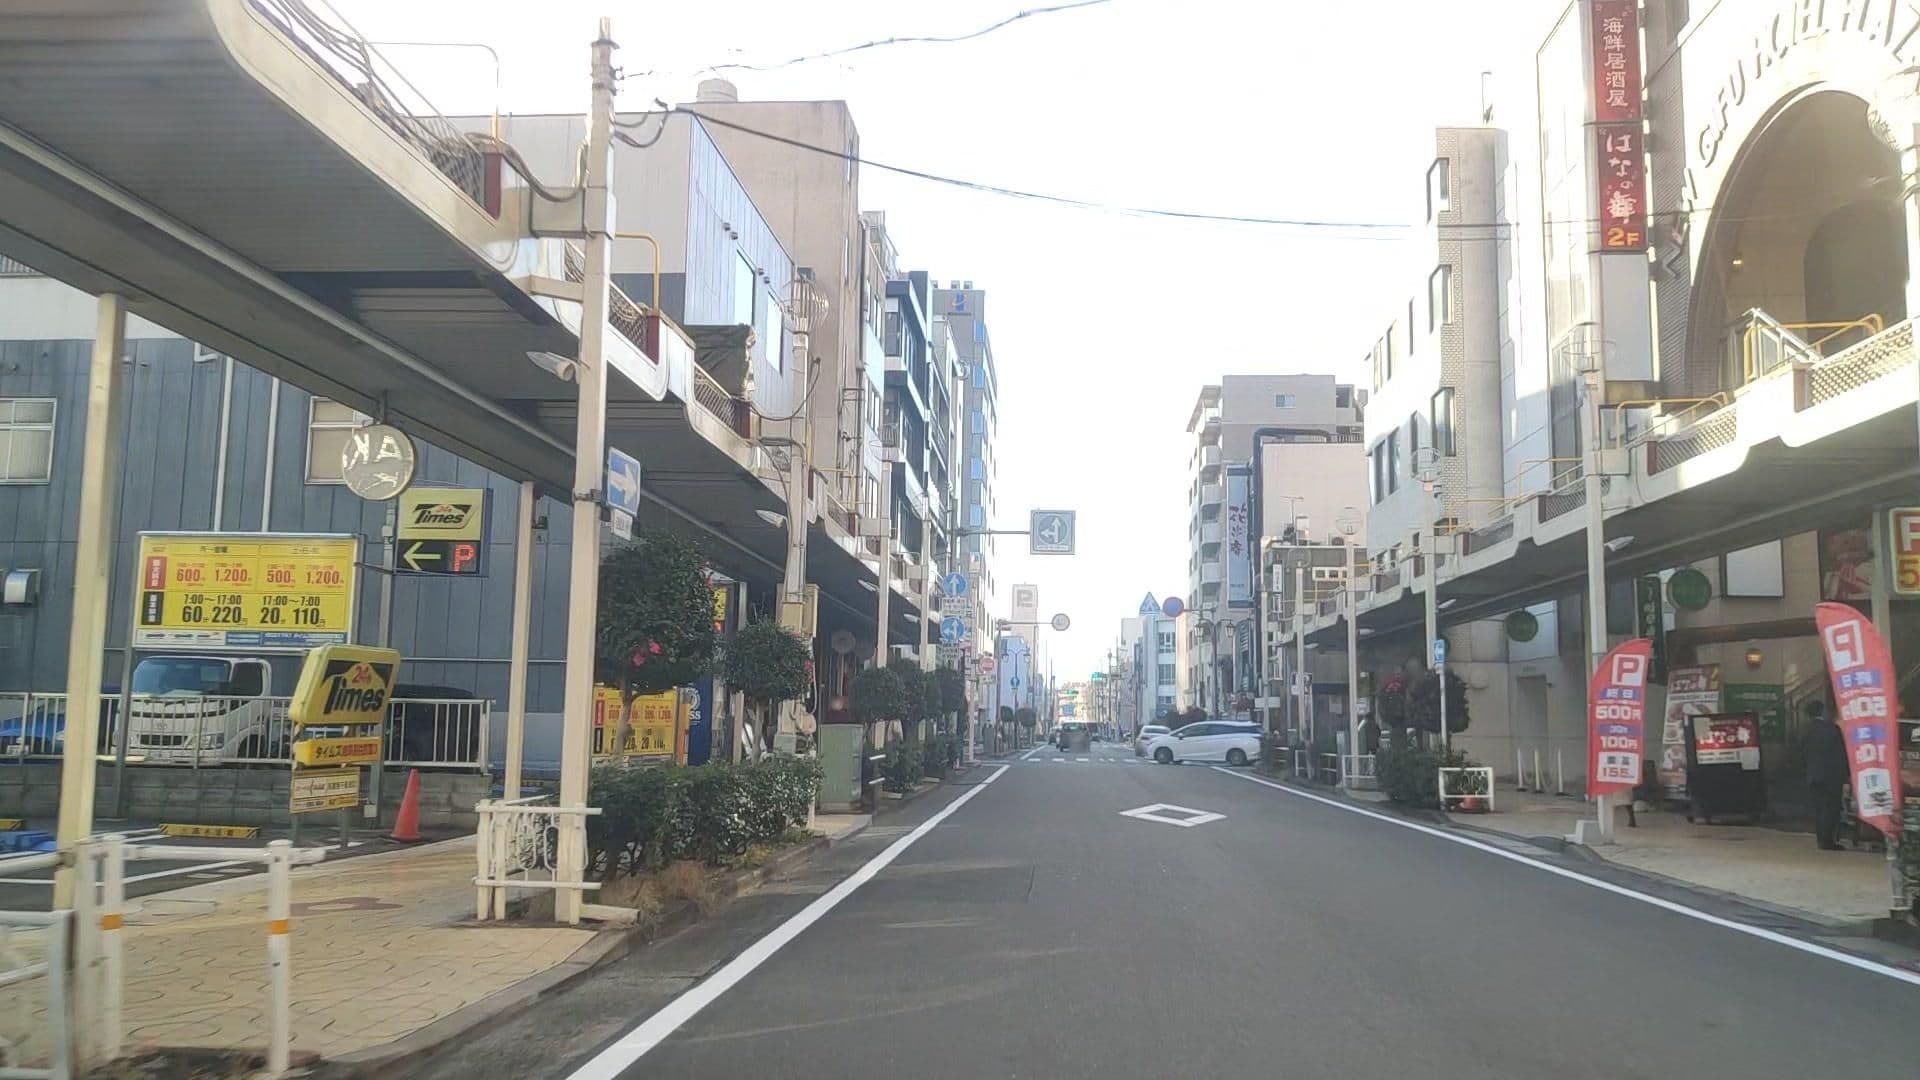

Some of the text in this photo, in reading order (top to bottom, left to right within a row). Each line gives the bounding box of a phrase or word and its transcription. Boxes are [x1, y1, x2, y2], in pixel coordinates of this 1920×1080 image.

[1603, 17, 1629, 108] 海鮮居酒屋
[1607, 228, 1640, 247] 2F
[414, 509, 465, 525] Times
[453, 544, 475, 572] P
[1617, 656, 1640, 683] P
[323, 676, 385, 715] Times
[1596, 705, 1642, 720] 500円
[1601, 736, 1638, 750] 100円
